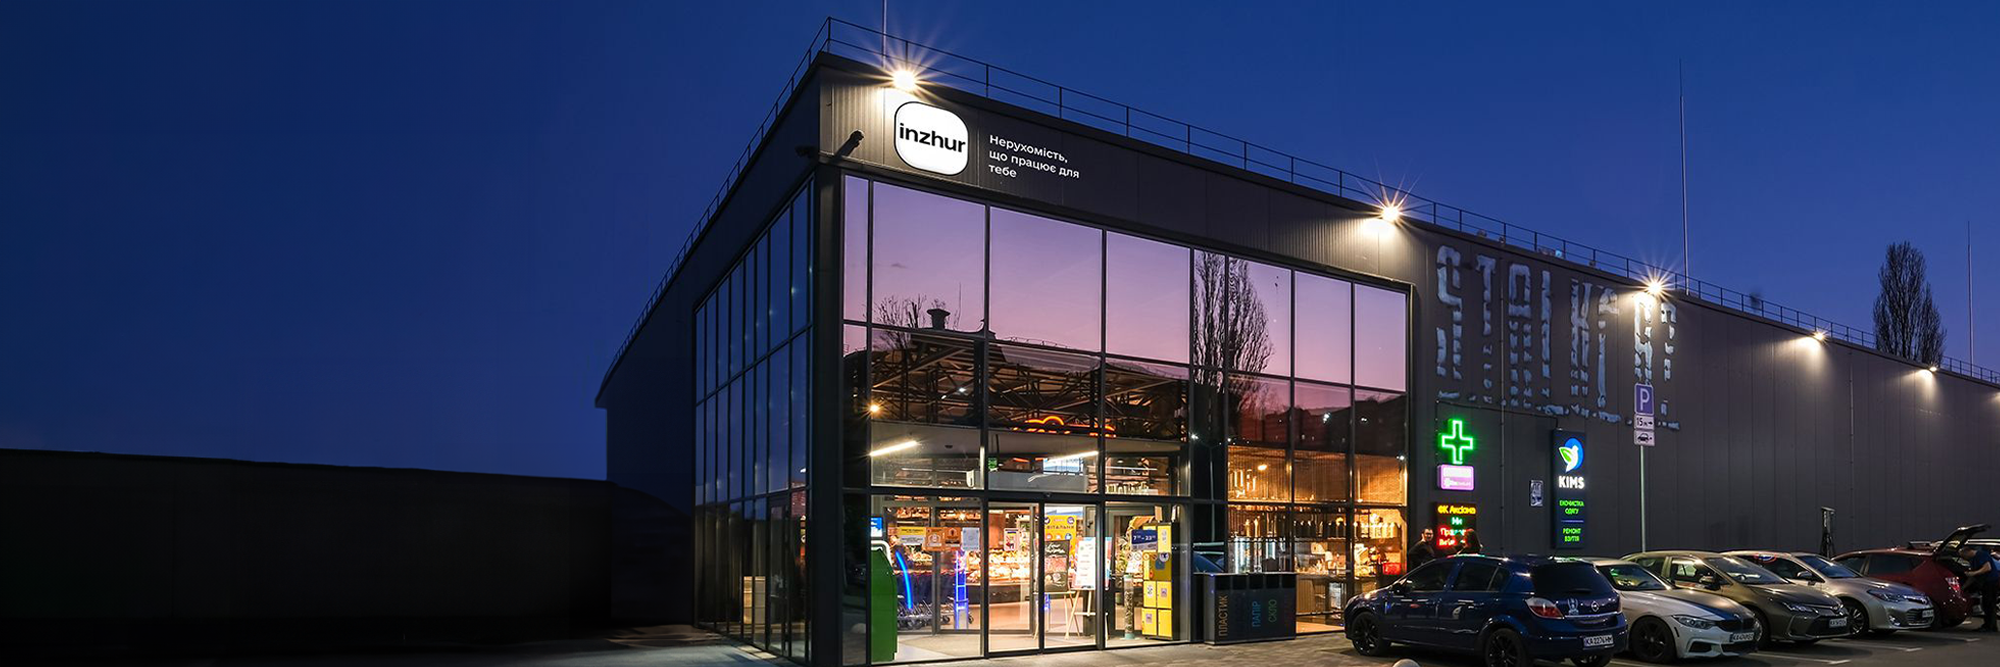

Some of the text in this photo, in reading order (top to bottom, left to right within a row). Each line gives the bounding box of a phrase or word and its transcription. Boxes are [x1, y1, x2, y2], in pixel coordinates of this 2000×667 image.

[899, 122, 966, 153] inzhur
[989, 134, 1068, 164] Нерухомість,
[988, 164, 1017, 178] тебе
[989, 150, 1080, 179] що працює для
[1640, 387, 1650, 411] P
[1558, 475, 1586, 490] KIMS
[1218, 594, 1228, 637] ПЛАСТИК
[1251, 600, 1261, 628] ПАПІР
[1268, 599, 1278, 623] СКЛО
